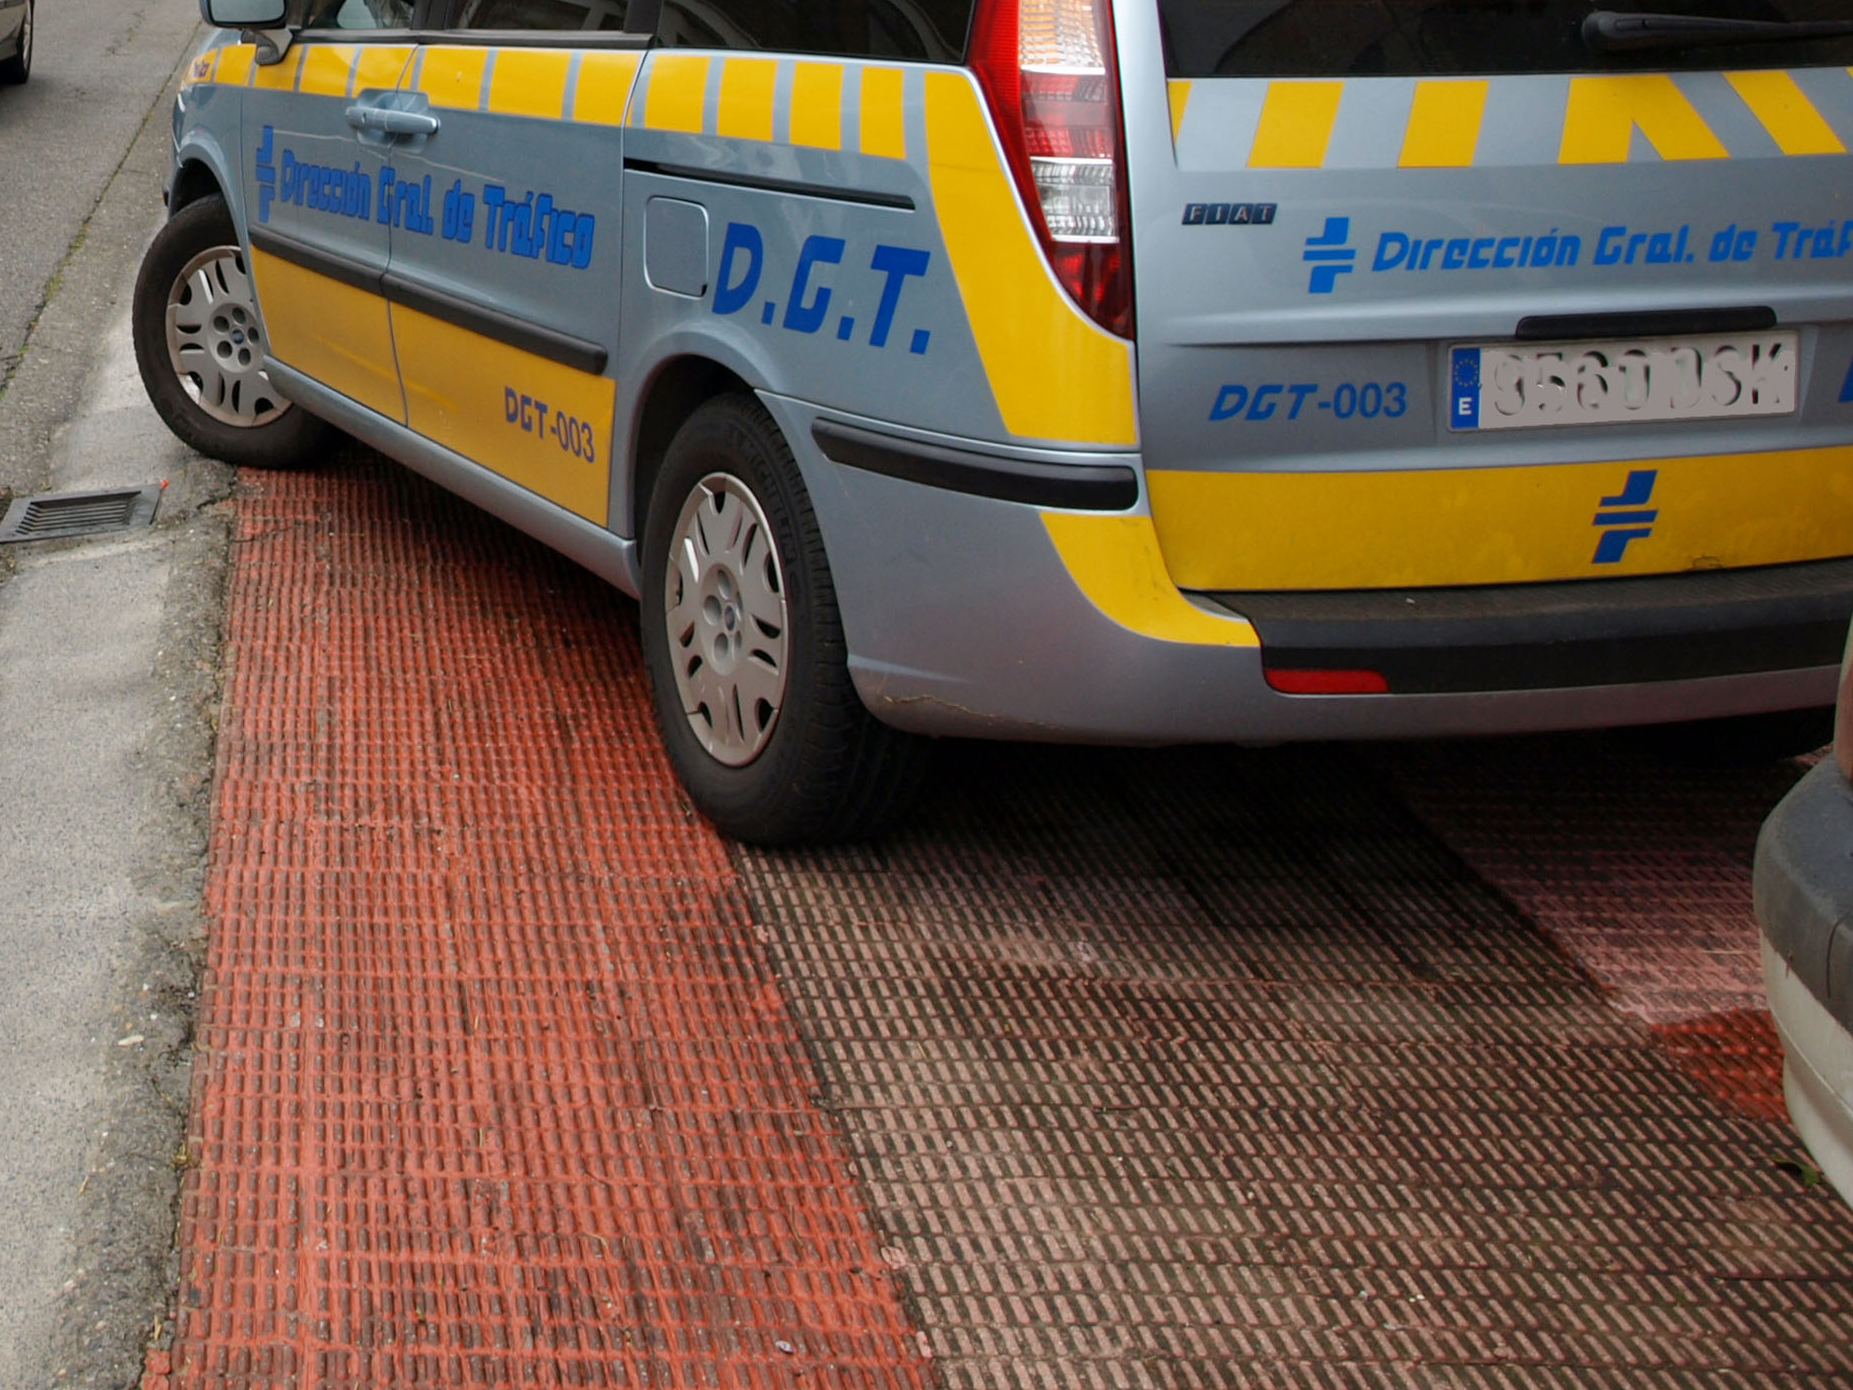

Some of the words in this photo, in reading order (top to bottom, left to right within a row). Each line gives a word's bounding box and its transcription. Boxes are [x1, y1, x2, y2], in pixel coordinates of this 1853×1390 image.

[280, 149, 372, 222] Dirección
[377, 166, 434, 236] Gral.
[442, 179, 476, 244] de
[483, 183, 596, 270] Tráfico
[1189, 204, 1272, 223] FIAT
[1372, 227, 1582, 272] Dirección
[1593, 224, 1695, 266] Gral.
[1708, 223, 1756, 262] de
[712, 222, 931, 356] D.G.T.
[504, 385, 595, 464] DGT-003
[1209, 382, 1407, 421] DGT-003
[1459, 397, 1473, 415] E
